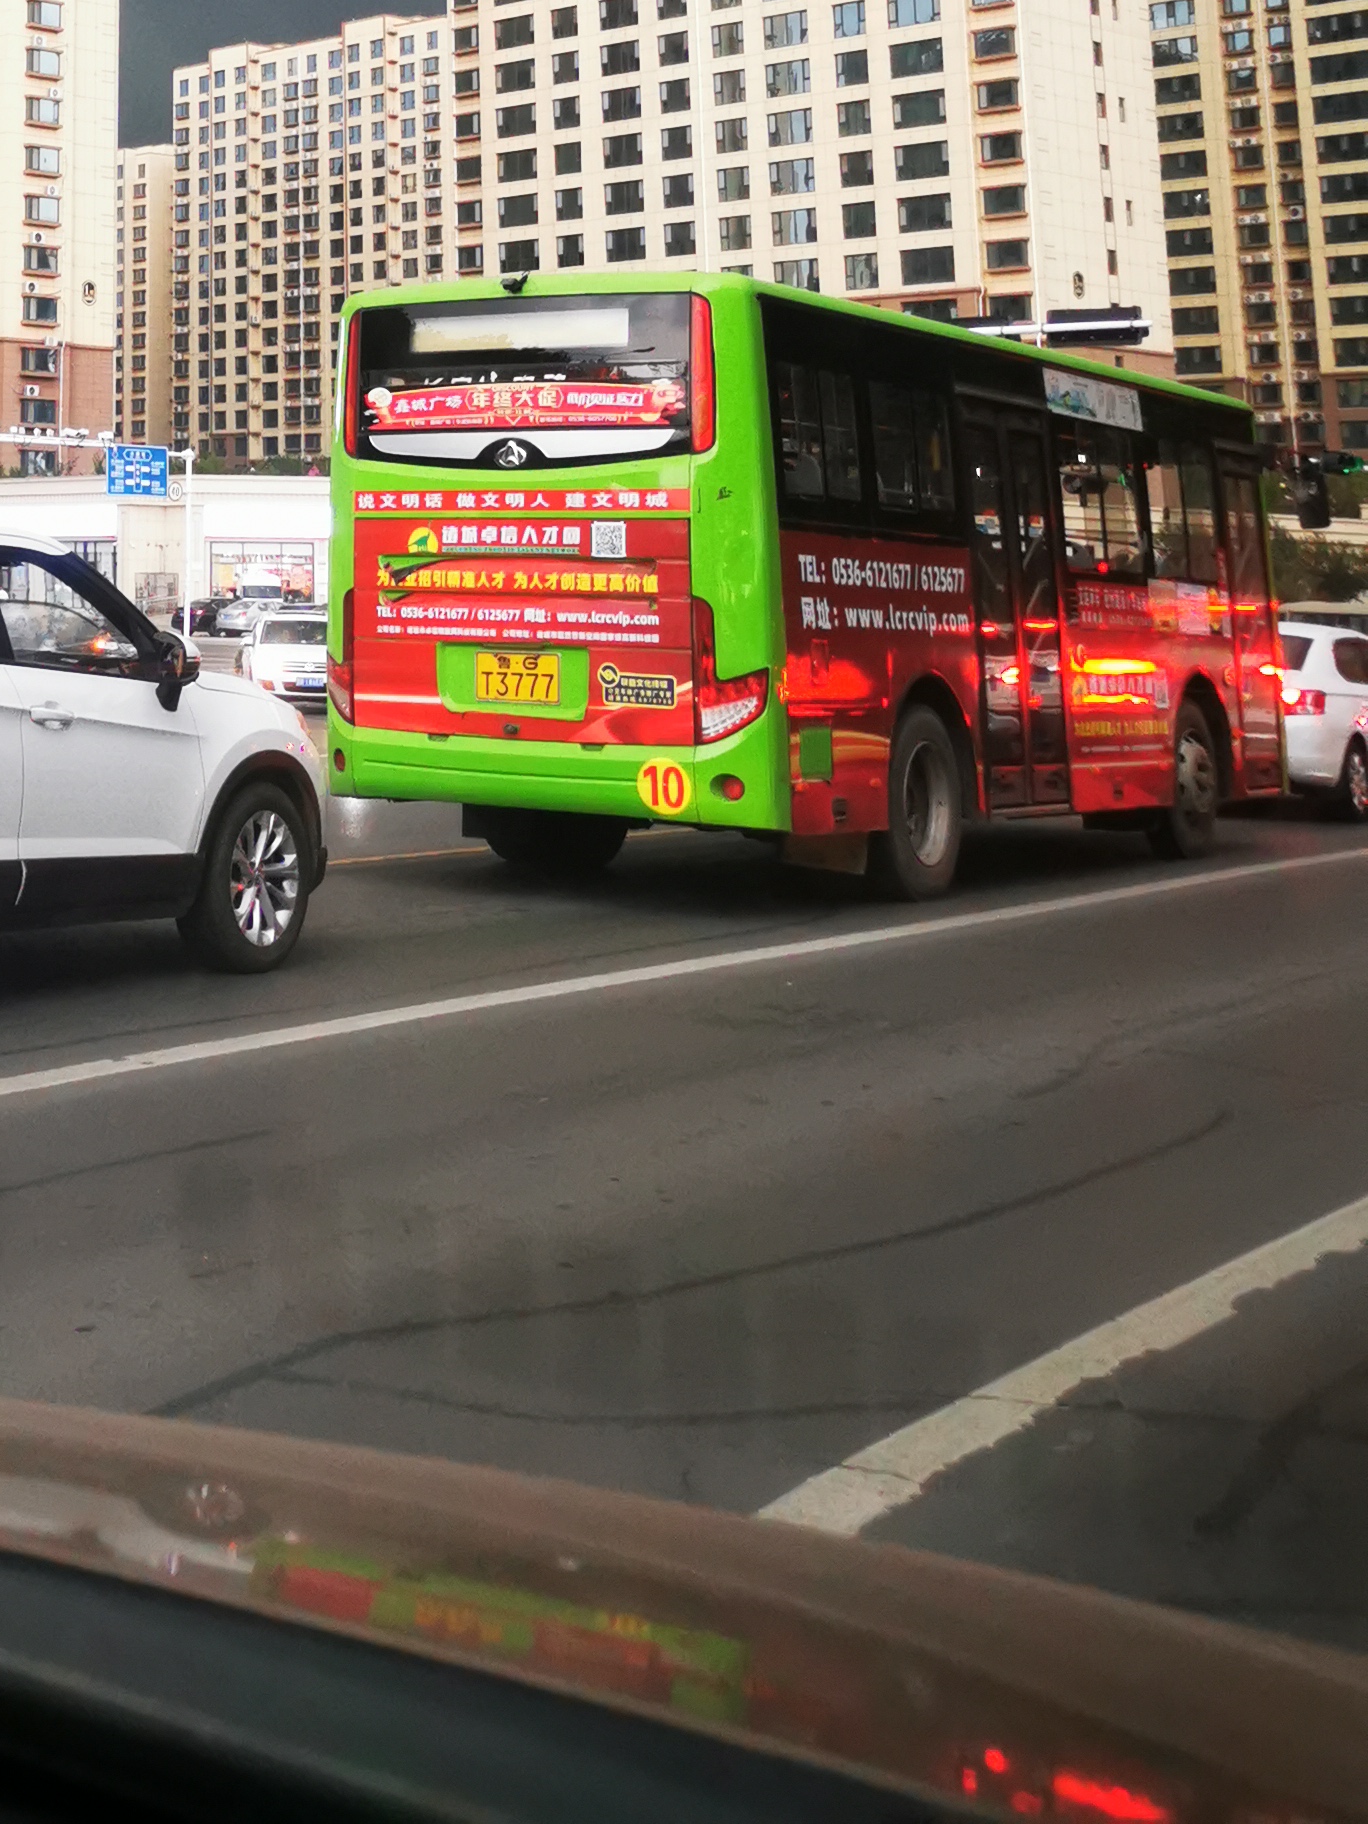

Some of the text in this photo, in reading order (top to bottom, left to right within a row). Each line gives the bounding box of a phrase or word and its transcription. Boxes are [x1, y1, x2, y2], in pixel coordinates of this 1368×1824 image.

[472, 389, 558, 408] 年终大促
[358, 492, 668, 509] 说文明话 做文明人 建文明城
[377, 569, 658, 593] 为业招引精准人才 为人才创造更高价值
[832, 557, 911, 590] 0536-6121677
[921, 566, 965, 593] 6125677
[401, 607, 468, 620] 0536-6121677
[477, 609, 520, 621] 6125677
[556, 610, 660, 627] www.lcrcvip.com
[844, 603, 970, 637] www.lcrcvip.com
[481, 672, 554, 698] T3777
[643, 765, 685, 810] 10
